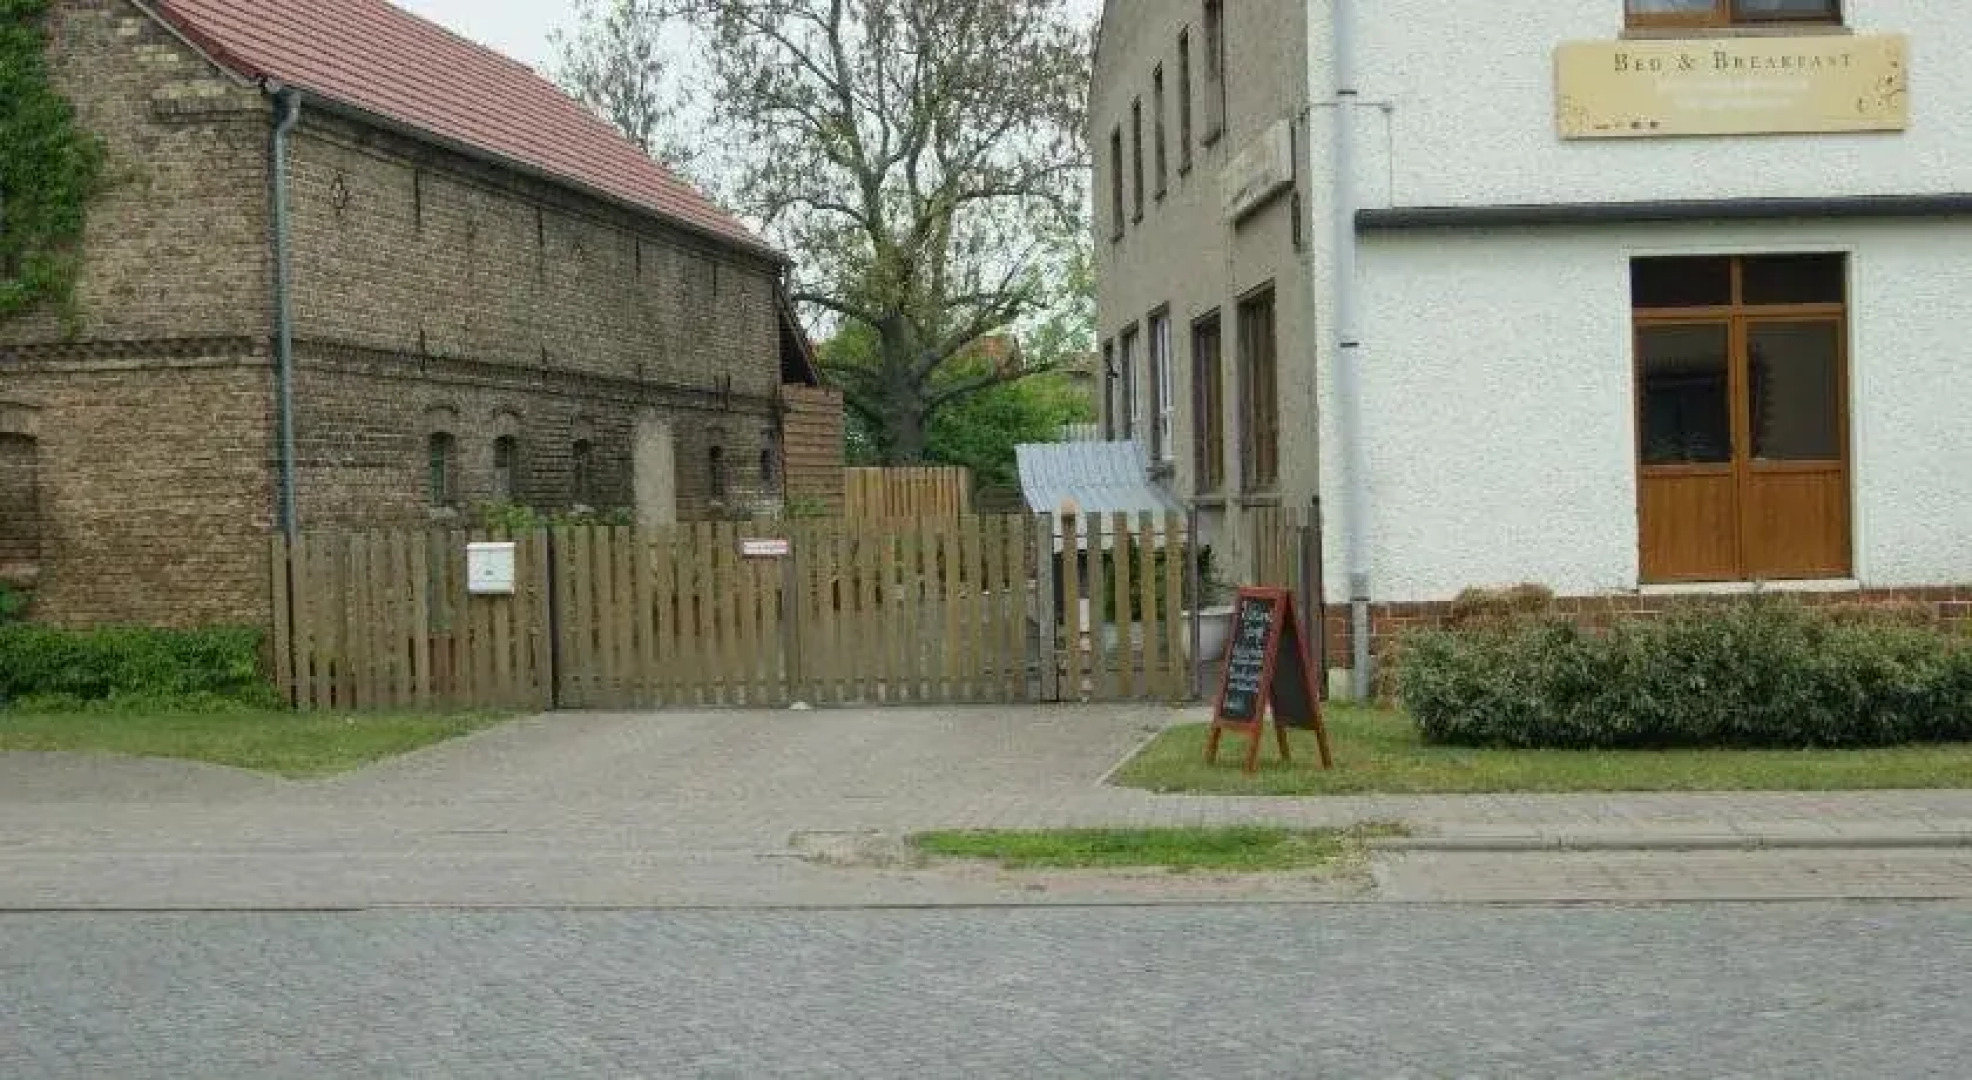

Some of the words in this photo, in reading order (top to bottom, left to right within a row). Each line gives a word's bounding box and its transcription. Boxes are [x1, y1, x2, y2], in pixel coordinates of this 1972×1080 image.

[1614, 53, 1662, 71] BED
[1677, 53, 1696, 71] &
[1713, 51, 1851, 70] BREAKFAST
